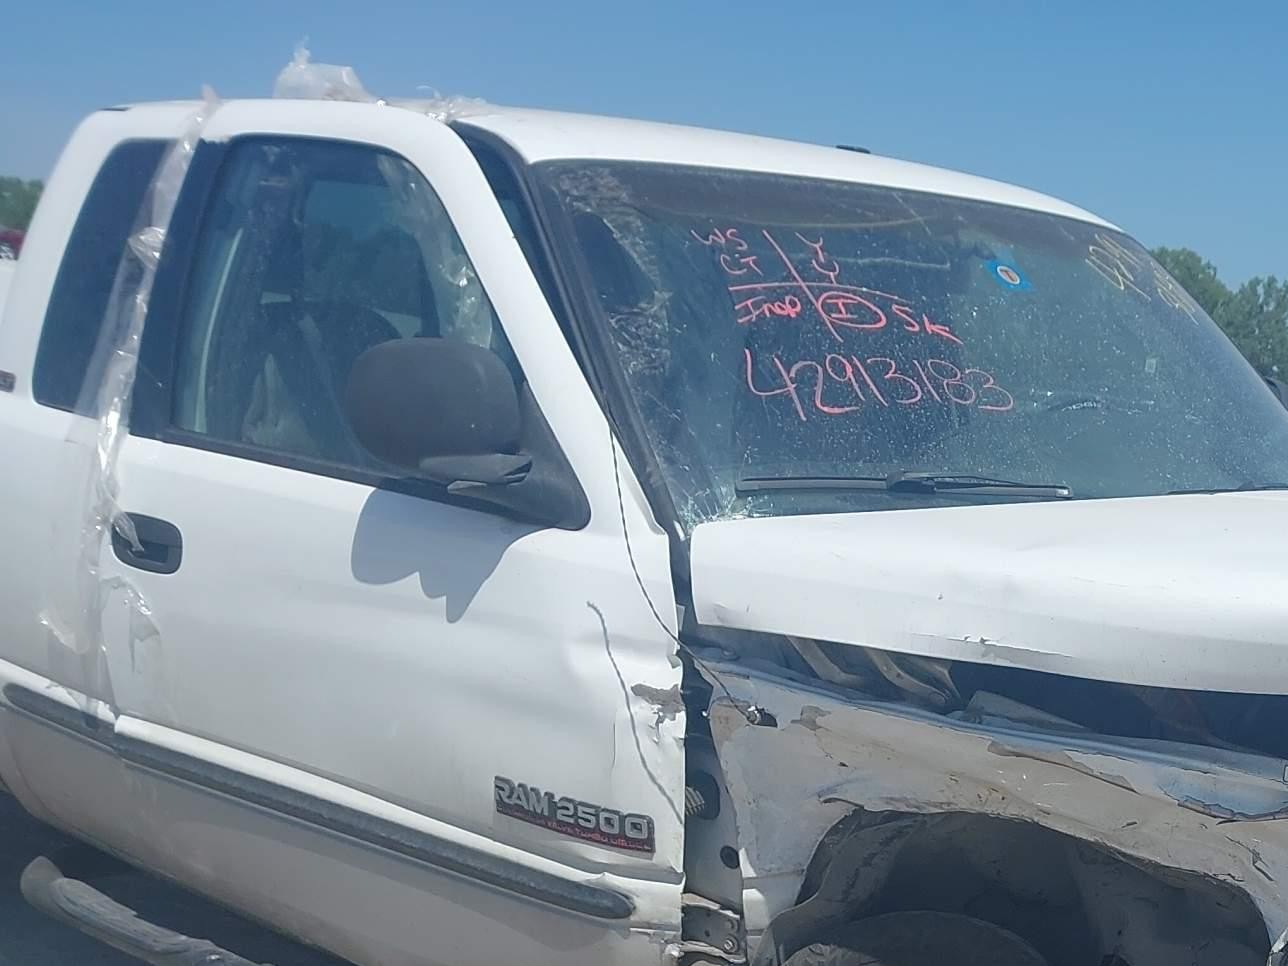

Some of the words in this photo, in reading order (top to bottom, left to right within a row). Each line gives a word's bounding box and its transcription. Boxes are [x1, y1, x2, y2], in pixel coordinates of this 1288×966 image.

[690, 228, 748, 250] WS
[745, 349, 1014, 422] 42913183
[495, 776, 556, 816] RAM
[555, 797, 654, 840] 2500
